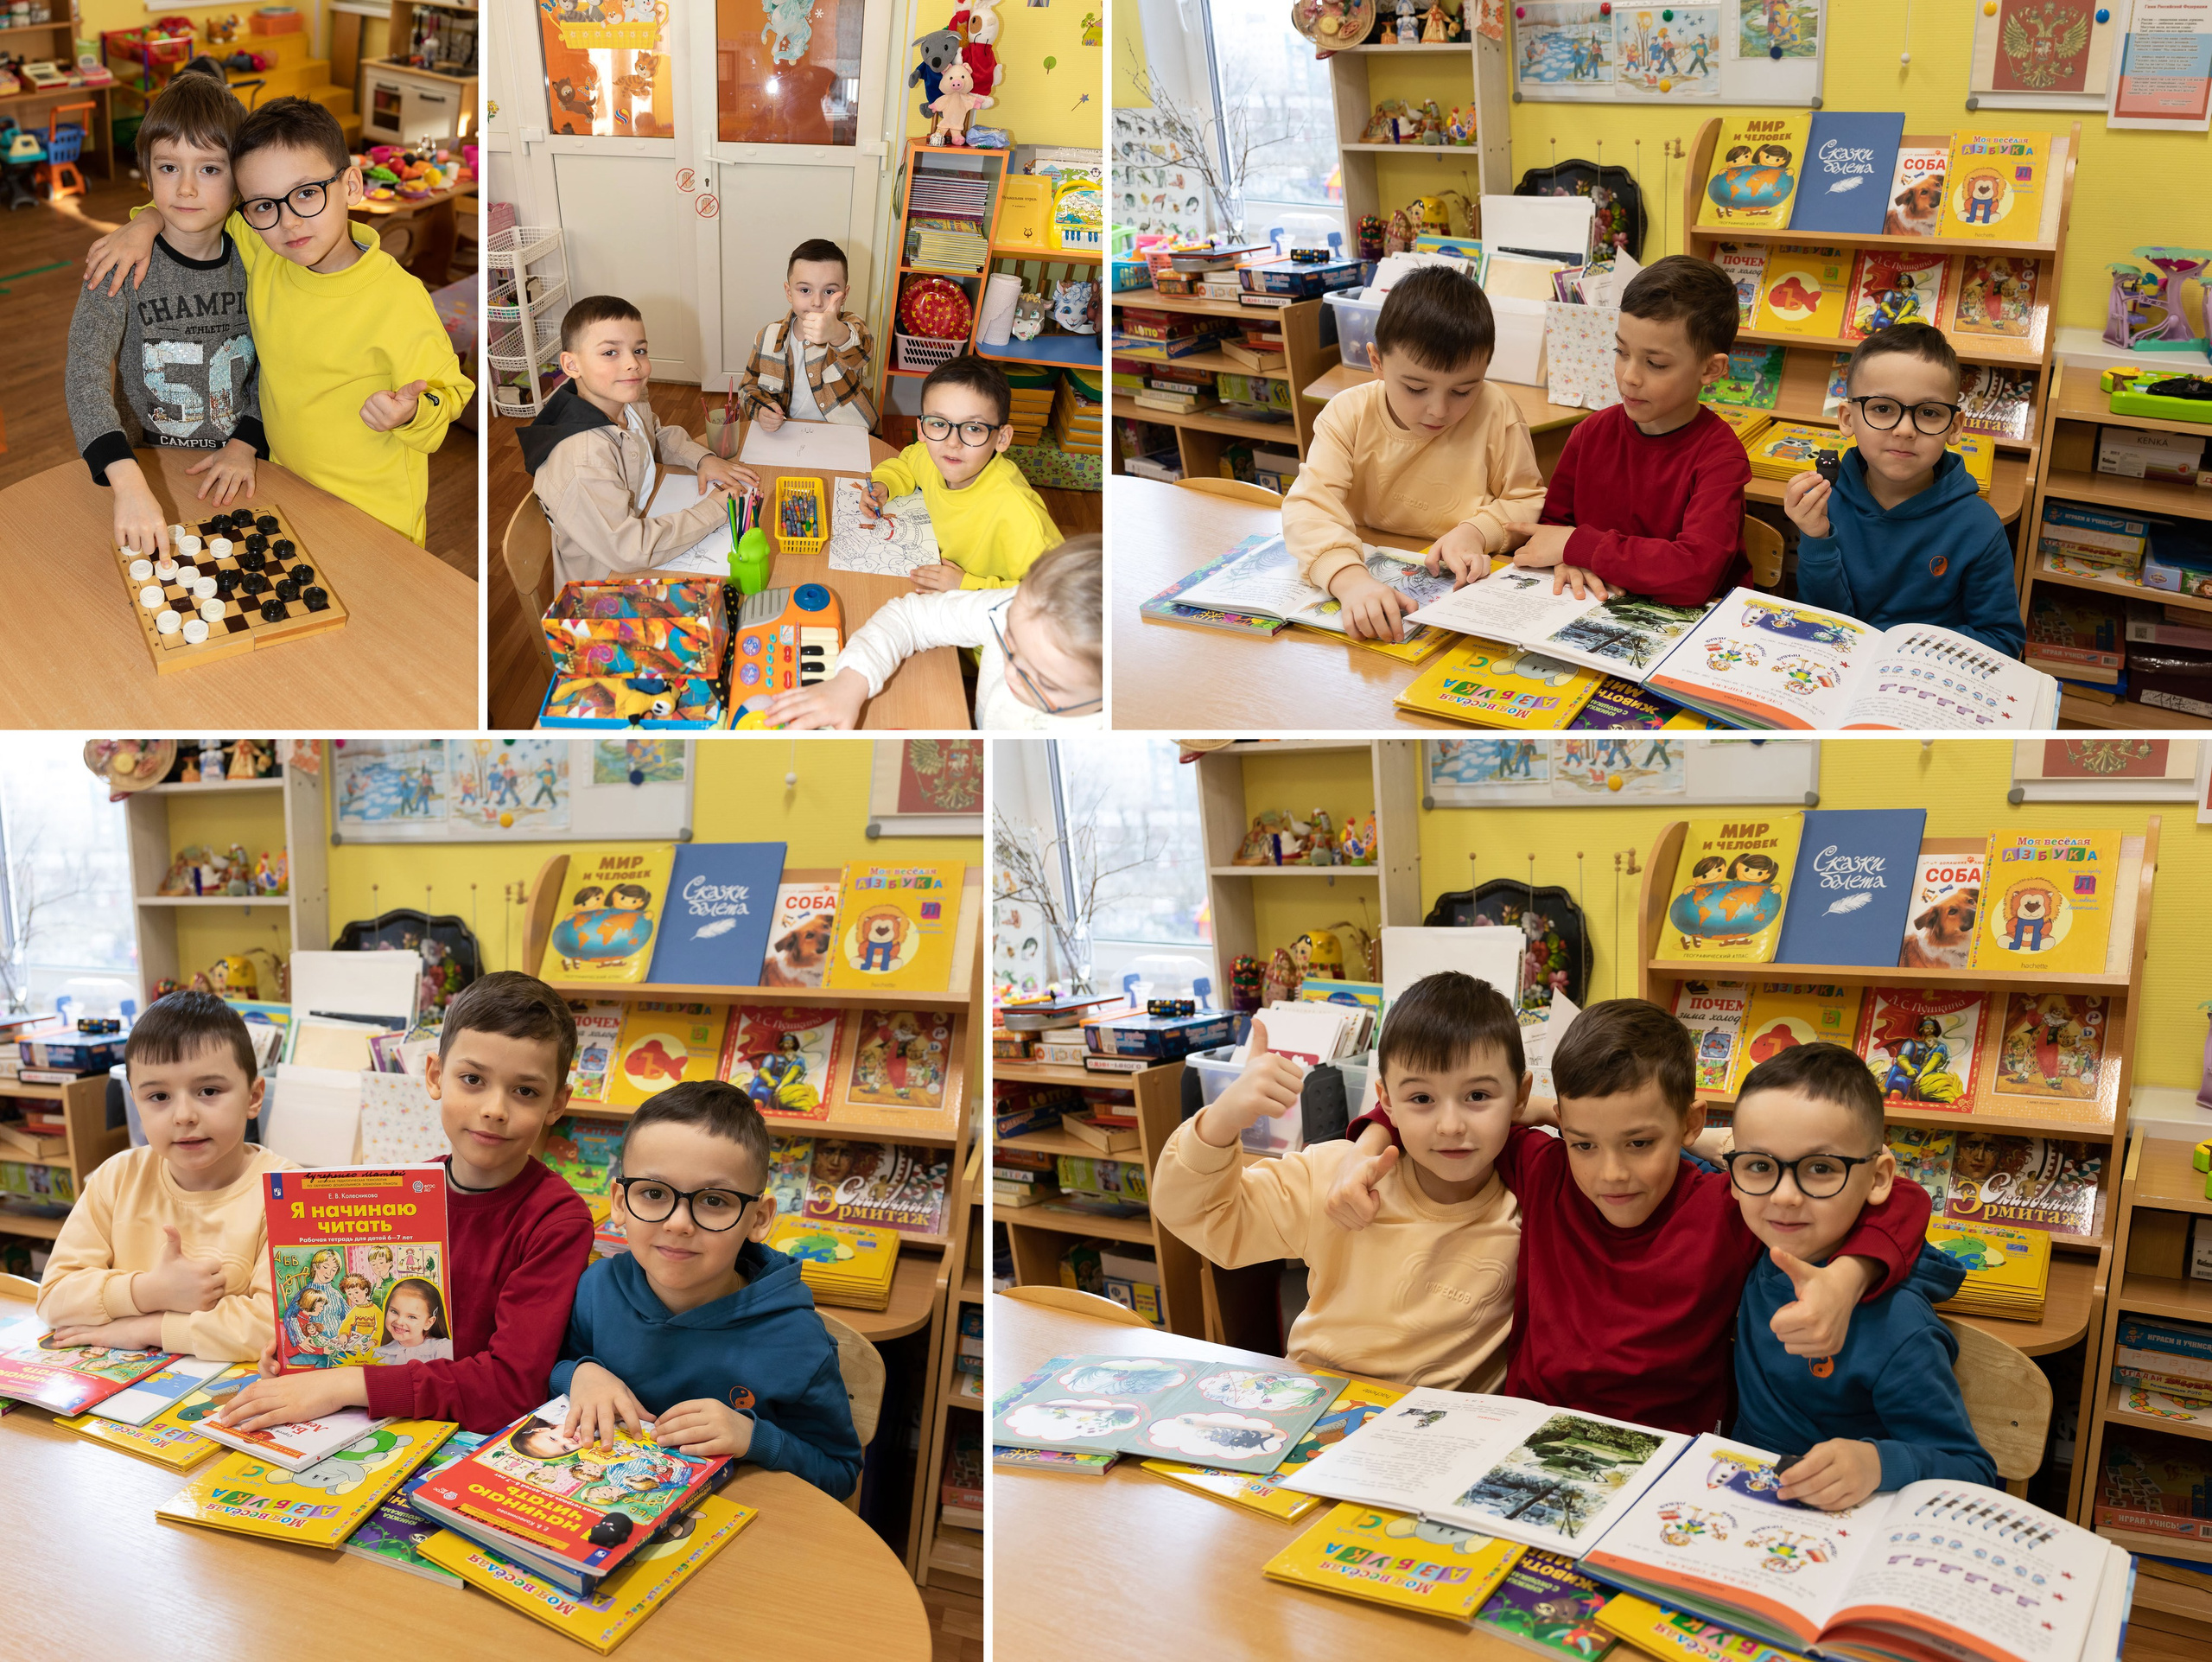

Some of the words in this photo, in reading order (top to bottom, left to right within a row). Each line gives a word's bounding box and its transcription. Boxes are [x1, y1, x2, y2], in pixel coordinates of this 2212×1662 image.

[1746, 120, 1785, 132] МИР
[1745, 132, 1792, 141] ЧЕЛОВЕК
[1818, 138, 1875, 162] Сказки
[1962, 144, 2034, 156] АЗБУКА
[1823, 159, 1875, 175] балета
[1779, 245, 1841, 258] АЗБУКА
[137, 291, 248, 327] CHAMPI
[184, 324, 230, 334] ATHLETIC
[142, 334, 257, 437] 50
[160, 436, 216, 448] CAMPUS
[2137, 436, 2169, 447] KENKÄ
[1443, 678, 1560, 709] АЗБУКА
[1438, 693, 1497, 711] весёлая
[1497, 704, 1531, 719] Моя
[1719, 823, 1770, 838] МИР
[1702, 841, 1713, 850] И
[1716, 838, 1779, 850] ЧЕЛОВЕК
[2017, 837, 2041, 845] Моя
[2044, 837, 2091, 845] весёлая
[1813, 844, 1887, 874] Сказки
[2002, 847, 2098, 862] АЗБУКА
[599, 856, 645, 869] МИР
[583, 872, 594, 881] И
[595, 869, 652, 881] ЧЕЛОВЕК
[869, 866, 891, 875] Моя
[683, 875, 750, 901] Сказки
[855, 876, 943, 890] АЗБУКА
[1820, 871, 1888, 890] балета
[689, 899, 750, 917] балета
[1764, 983, 1844, 997] АЗБУКА
[1900, 1000, 1910, 1010] С.
[1911, 997, 1967, 1015] Пушкина
[290, 1201, 305, 1219] Я
[311, 1202, 417, 1219] начинаю
[810, 1183, 931, 1226] Эрмитаж
[1952, 1180, 2082, 1226] Эрмитаж
[318, 1219, 393, 1234] читать
[2147, 1334, 2176, 1345] ИГРАЕМ
[1362, 1386, 1392, 1398] hachette
[143, 1435, 172, 1449] Моя
[243, 1466, 265, 1477] С
[1244, 1480, 1275, 1498] Моя
[205, 1502, 271, 1520] весёлая
[212, 1488, 343, 1519] АЗБУКА
[467, 1483, 582, 1532] начинаю
[506, 1485, 584, 1522] читать
[270, 1515, 308, 1528] Моя
[382, 1512, 418, 1526] КНИЖКА
[496, 1507, 536, 1527] Колесникова
[1359, 1514, 1382, 1529] С
[1325, 1542, 1471, 1582] АЗБУКА
[467, 1552, 537, 1599] весёлая
[1318, 1560, 1389, 1586] весёлая
[1391, 1576, 1437, 1595] Моя
[536, 1589, 577, 1617] Моя
